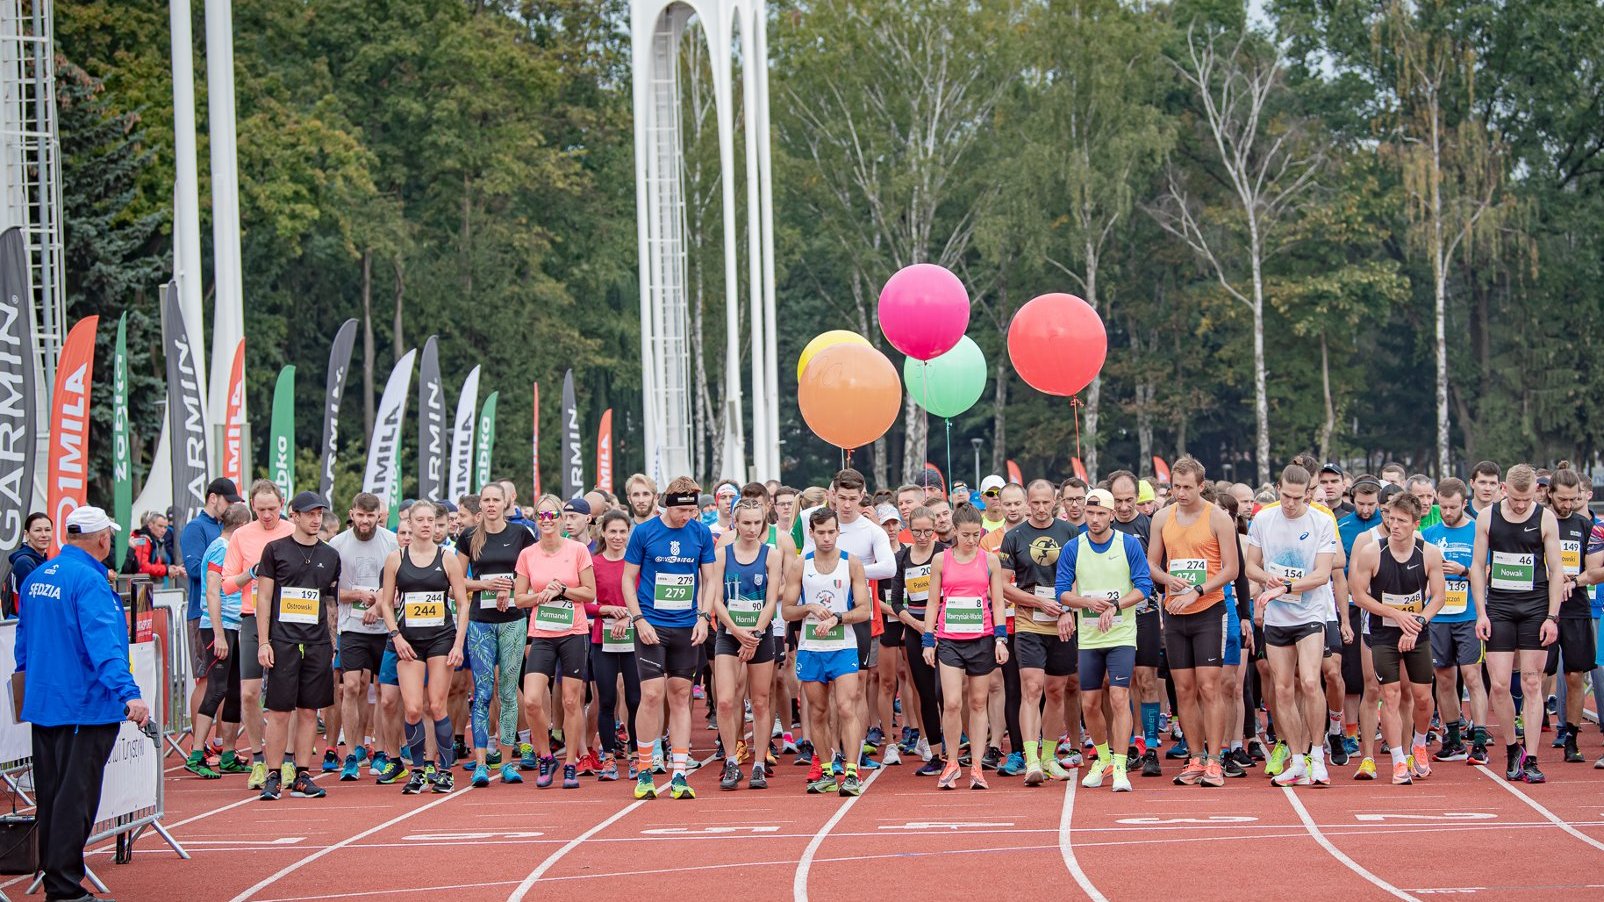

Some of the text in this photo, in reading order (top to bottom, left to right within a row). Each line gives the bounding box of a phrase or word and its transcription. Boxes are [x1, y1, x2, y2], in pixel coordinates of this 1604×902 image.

[427, 381, 441, 502] ARMIN
[478, 416, 490, 487] abka
[568, 408, 584, 499] ARMIN
[275, 436, 288, 508] abka
[1564, 542, 1579, 551] 149
[1186, 560, 1205, 570] 274
[1520, 556, 1532, 565] 46
[1284, 569, 1302, 579] 154
[1501, 568, 1523, 577] Nowak
[678, 577, 693, 585] 279
[29, 582, 61, 599] SĘDZIA
[1449, 583, 1466, 591] 139
[301, 590, 318, 600] 197
[665, 588, 686, 598] 279
[426, 594, 442, 603] 244
[976, 599, 982, 608] 8
[1404, 594, 1420, 605] 248
[286, 602, 313, 611] Ostrowski
[562, 600, 573, 609] 73
[752, 602, 762, 611] 90
[414, 605, 437, 617] 244
[540, 610, 569, 620] Furmanek
[735, 615, 757, 624] Hornik
